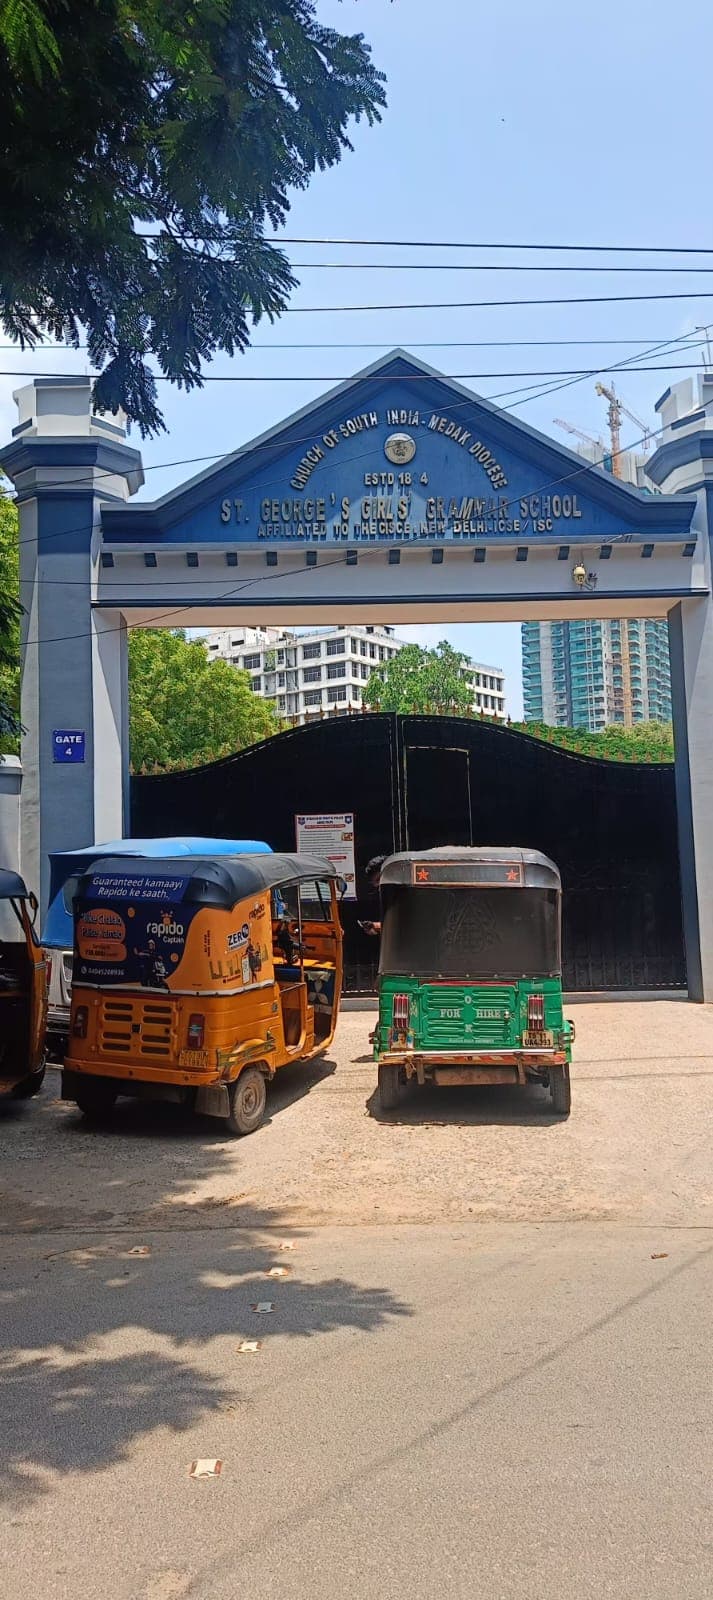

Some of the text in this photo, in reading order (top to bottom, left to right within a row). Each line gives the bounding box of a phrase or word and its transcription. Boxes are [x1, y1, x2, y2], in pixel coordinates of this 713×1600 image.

[290, 444, 325, 489] CHURCH
[322, 429, 340, 448] OF
[339, 411, 378, 437] SOUTH
[468, 441, 508, 489] DIOCESE
[364, 472, 394, 485] ESTD
[221, 499, 250, 522] ST.
[520, 494, 582, 518] SCHOOL
[258, 522, 328, 537] AFFILIATED
[333, 522, 349, 536] TO
[55, 735, 83, 744] GATE
[64, 747, 73, 755] 4
[92, 876, 184, 890] Guaranteed kamaayi
[98, 887, 128, 898] Rapido
[129, 888, 141, 897] ke
[146, 921, 184, 937] rapido
[440, 1008, 501, 1018] FOR HIRE
